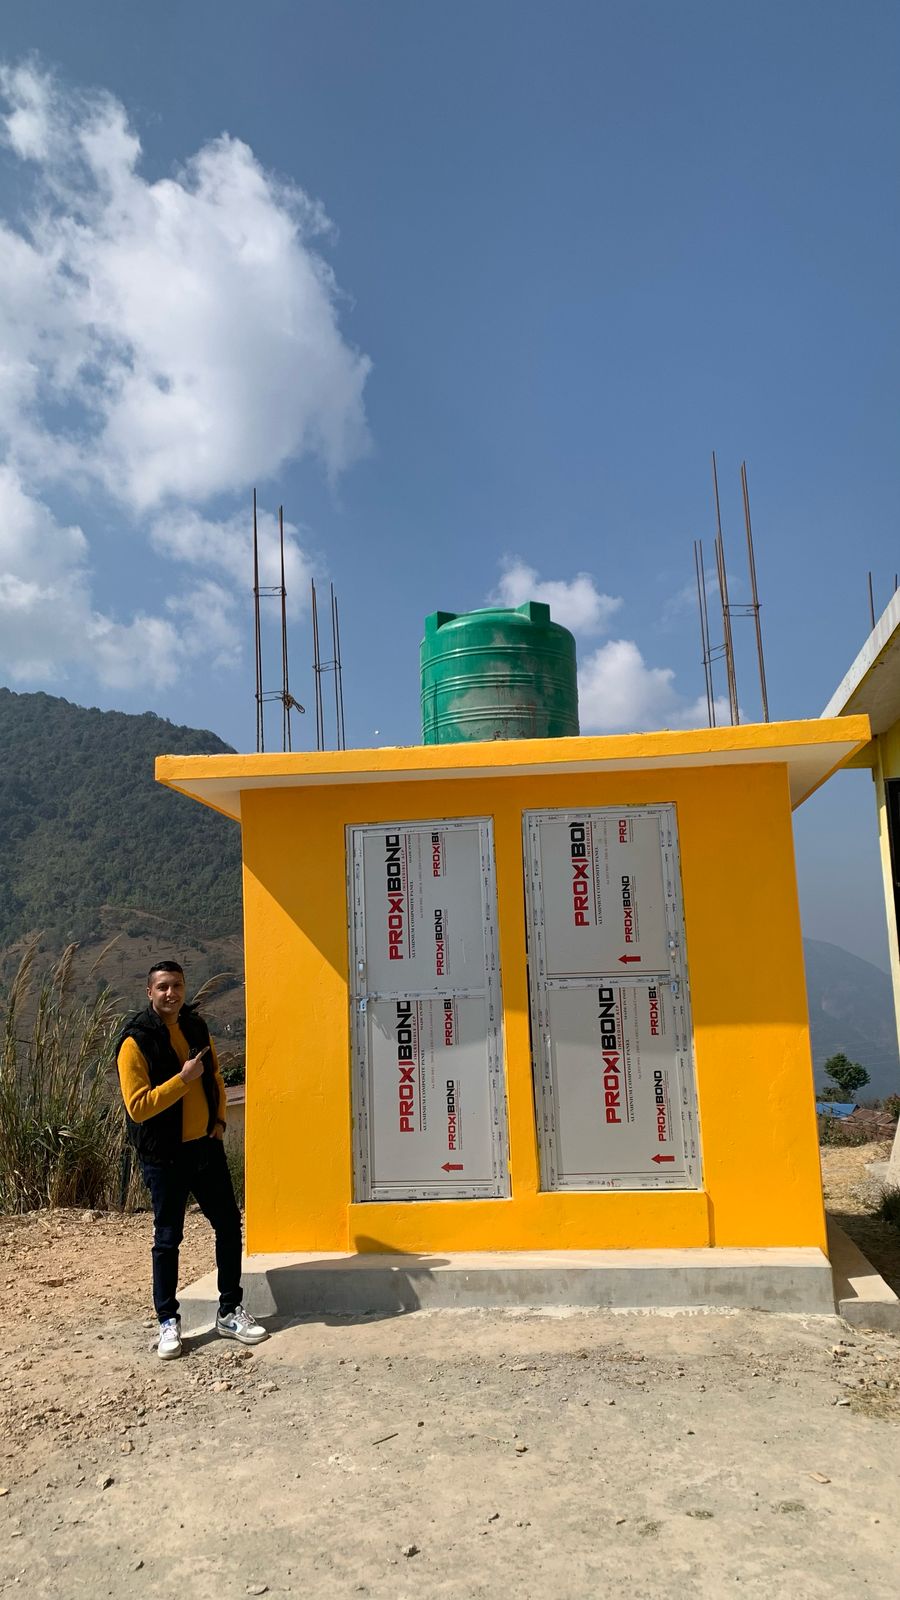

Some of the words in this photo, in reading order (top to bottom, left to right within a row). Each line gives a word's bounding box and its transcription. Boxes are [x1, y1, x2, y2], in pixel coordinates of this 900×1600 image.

[385, 834, 404, 960] PROXIBOND
[621, 875, 633, 943] PROXIBOND
[434, 909, 445, 976] PROXIBOND
[395, 1000, 415, 1133] PROXIBOND
[598, 987, 622, 1124] PROXIBOND
[446, 1079, 457, 1150] PROXIBOND
[653, 1070, 667, 1142] PROXIBOND
